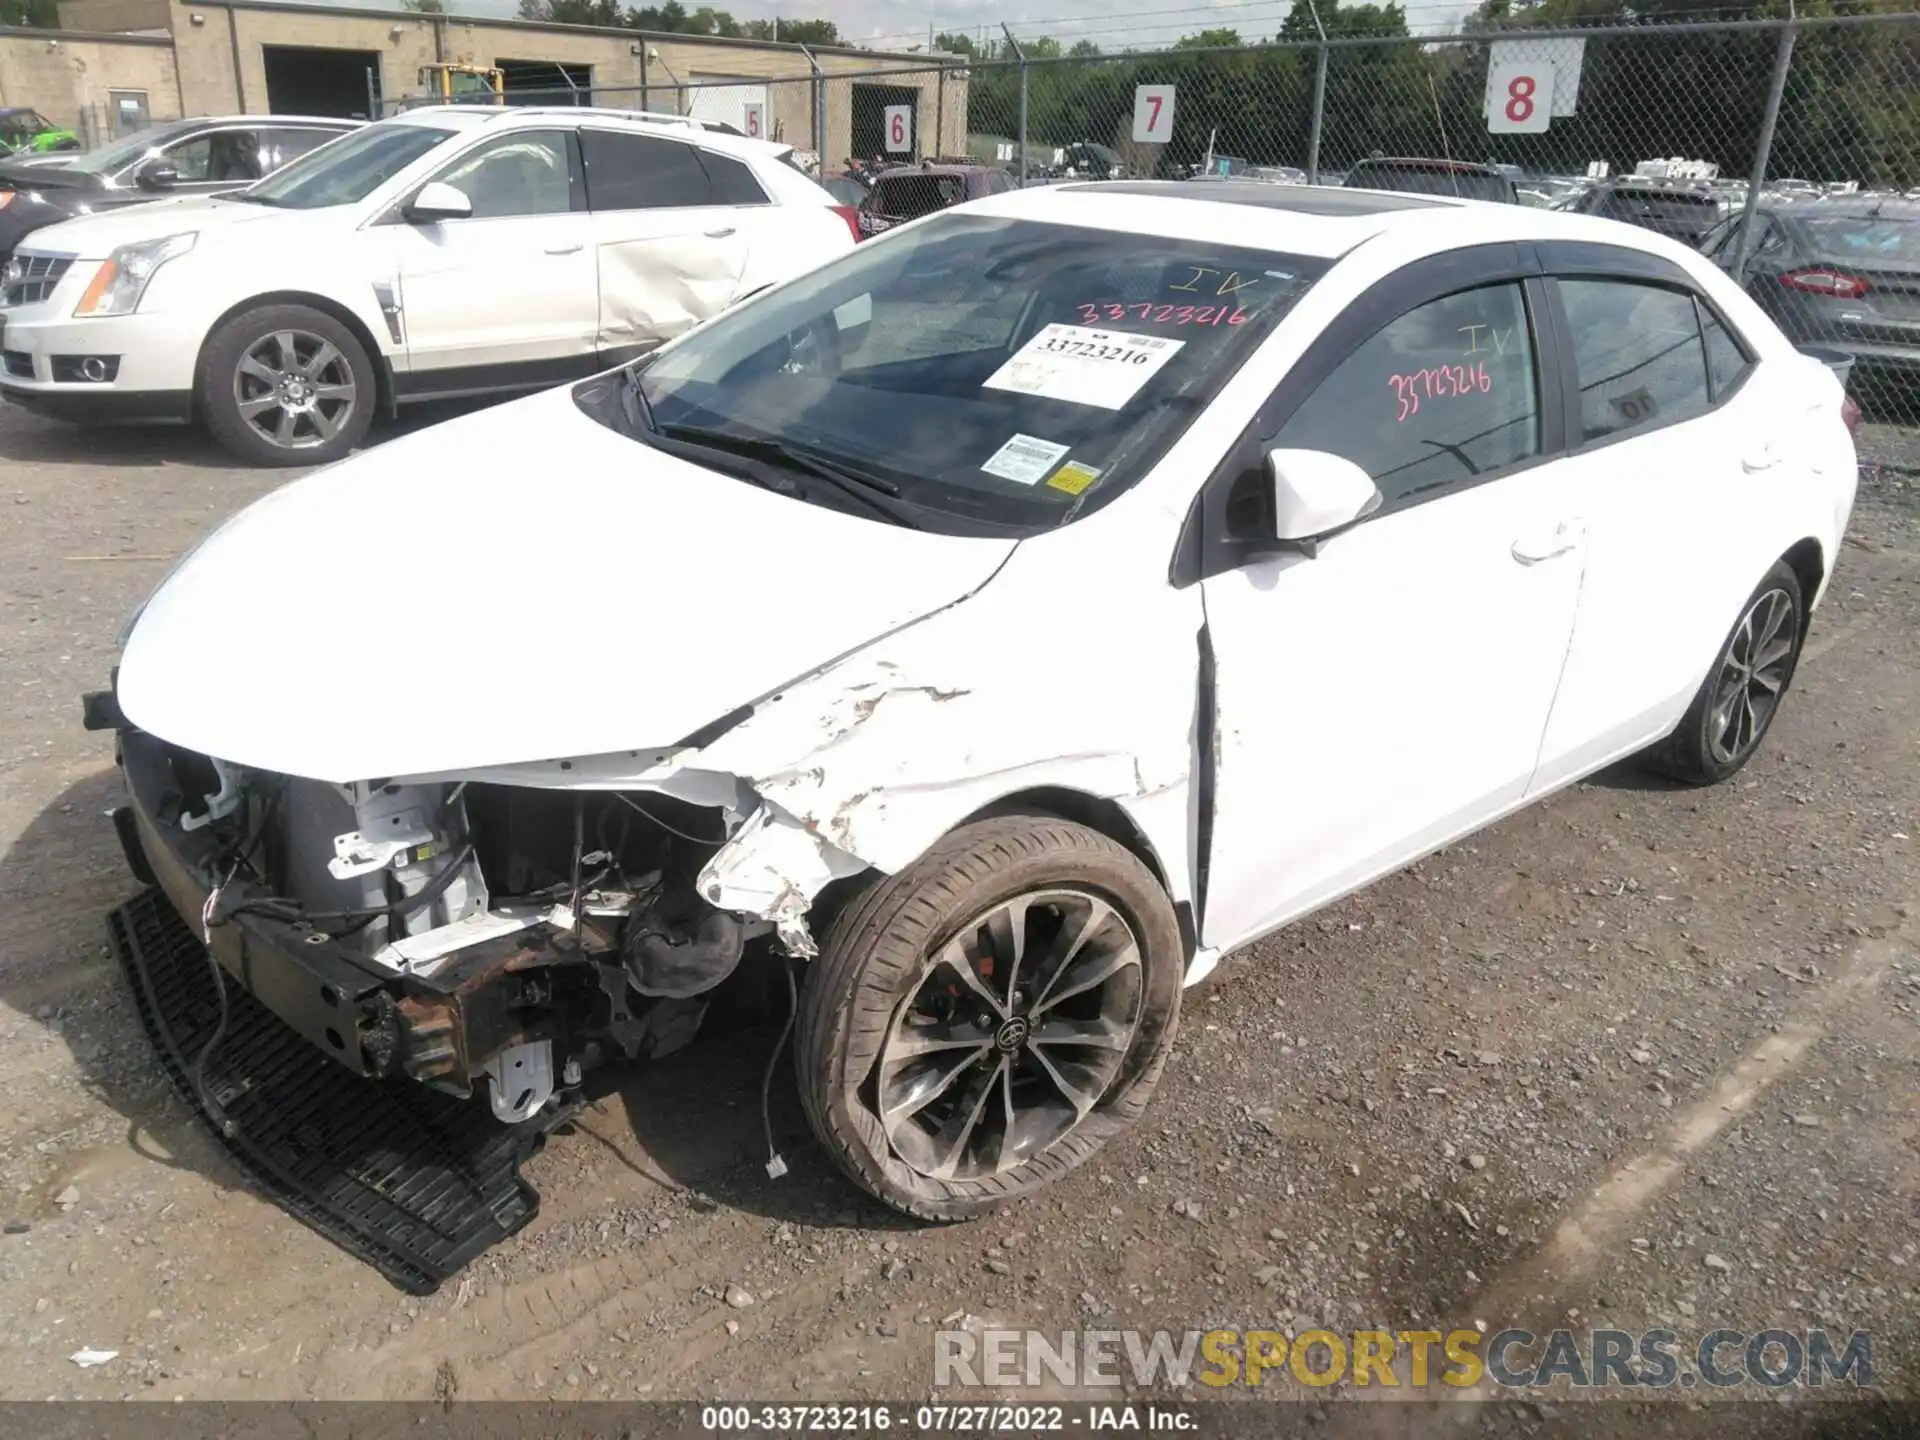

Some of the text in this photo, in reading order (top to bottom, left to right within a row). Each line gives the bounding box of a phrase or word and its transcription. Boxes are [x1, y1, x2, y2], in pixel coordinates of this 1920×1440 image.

[1146, 96, 1162, 132] 7
[1505, 76, 1535, 122] 8
[749, 111, 758, 136] 5
[891, 113, 904, 144] 6
[1077, 303, 1249, 326] 33723216
[1037, 338, 1149, 365] 33723216
[1388, 361, 1492, 421] 33723216
